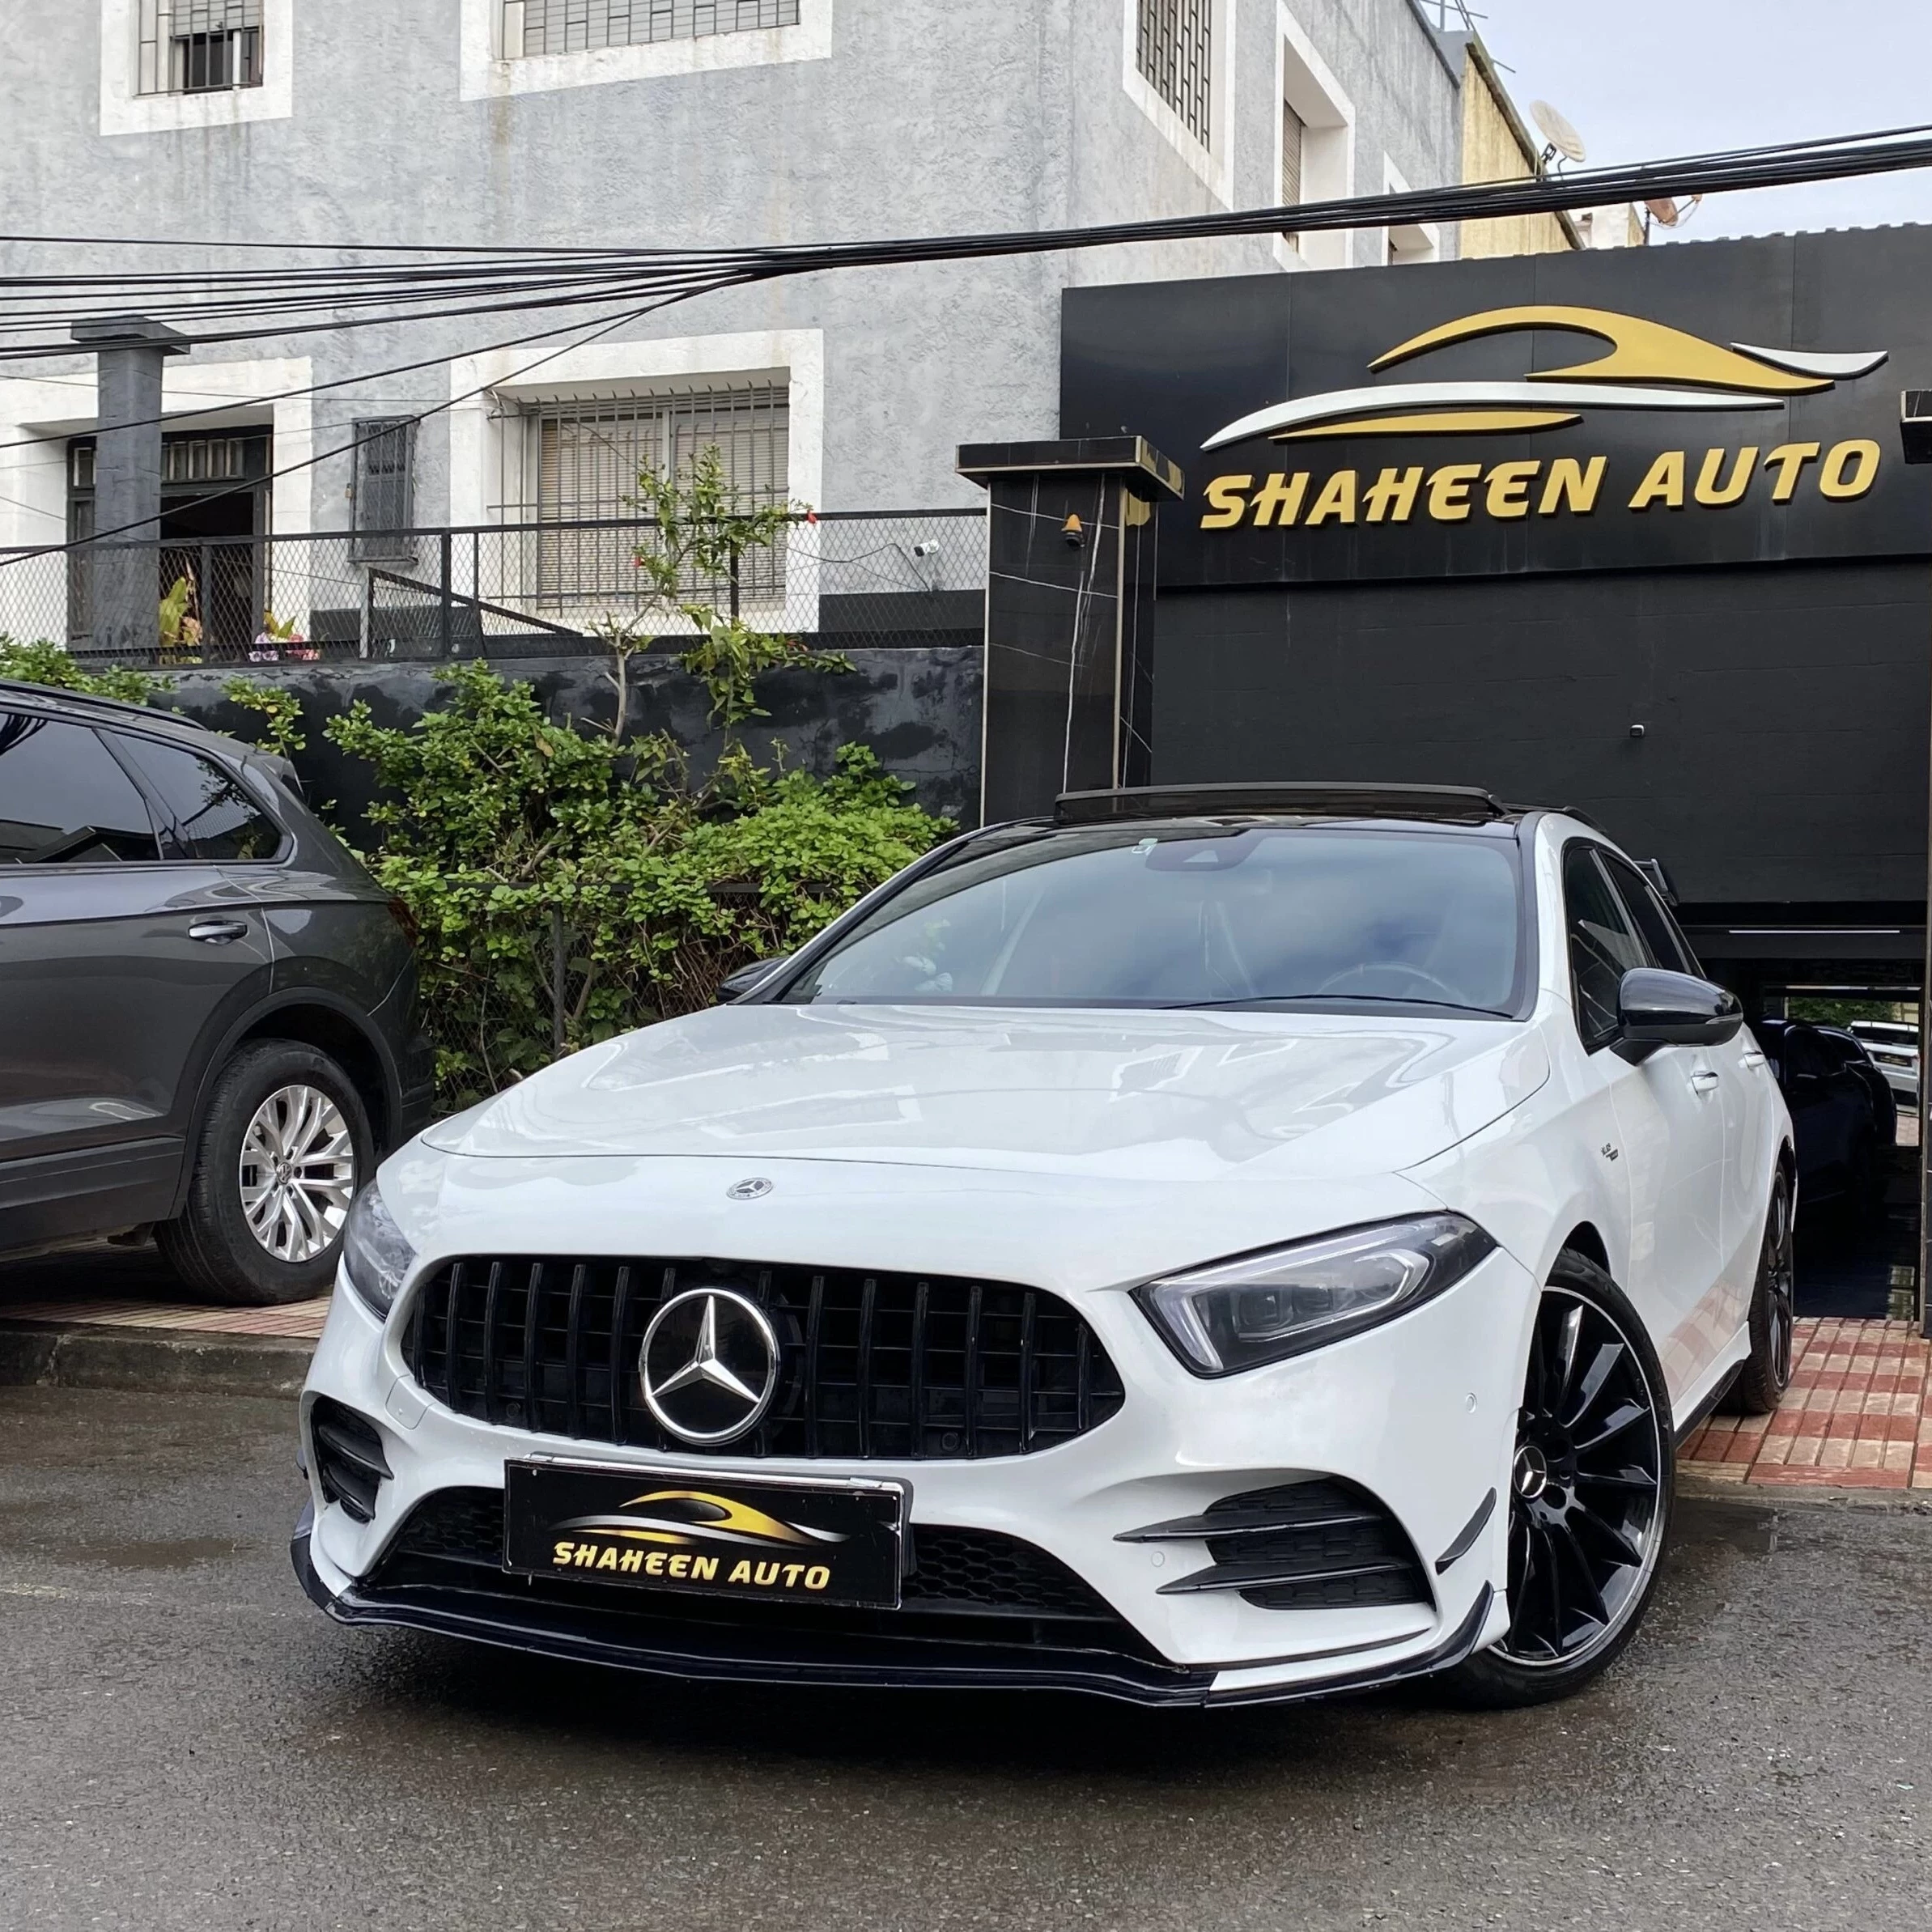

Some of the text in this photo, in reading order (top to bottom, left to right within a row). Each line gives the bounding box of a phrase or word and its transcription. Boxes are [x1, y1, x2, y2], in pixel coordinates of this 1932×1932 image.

[1200, 439, 1882, 530] SHAHEEN AUTO
[553, 1541, 830, 1590] SHAHEEN AUTO
